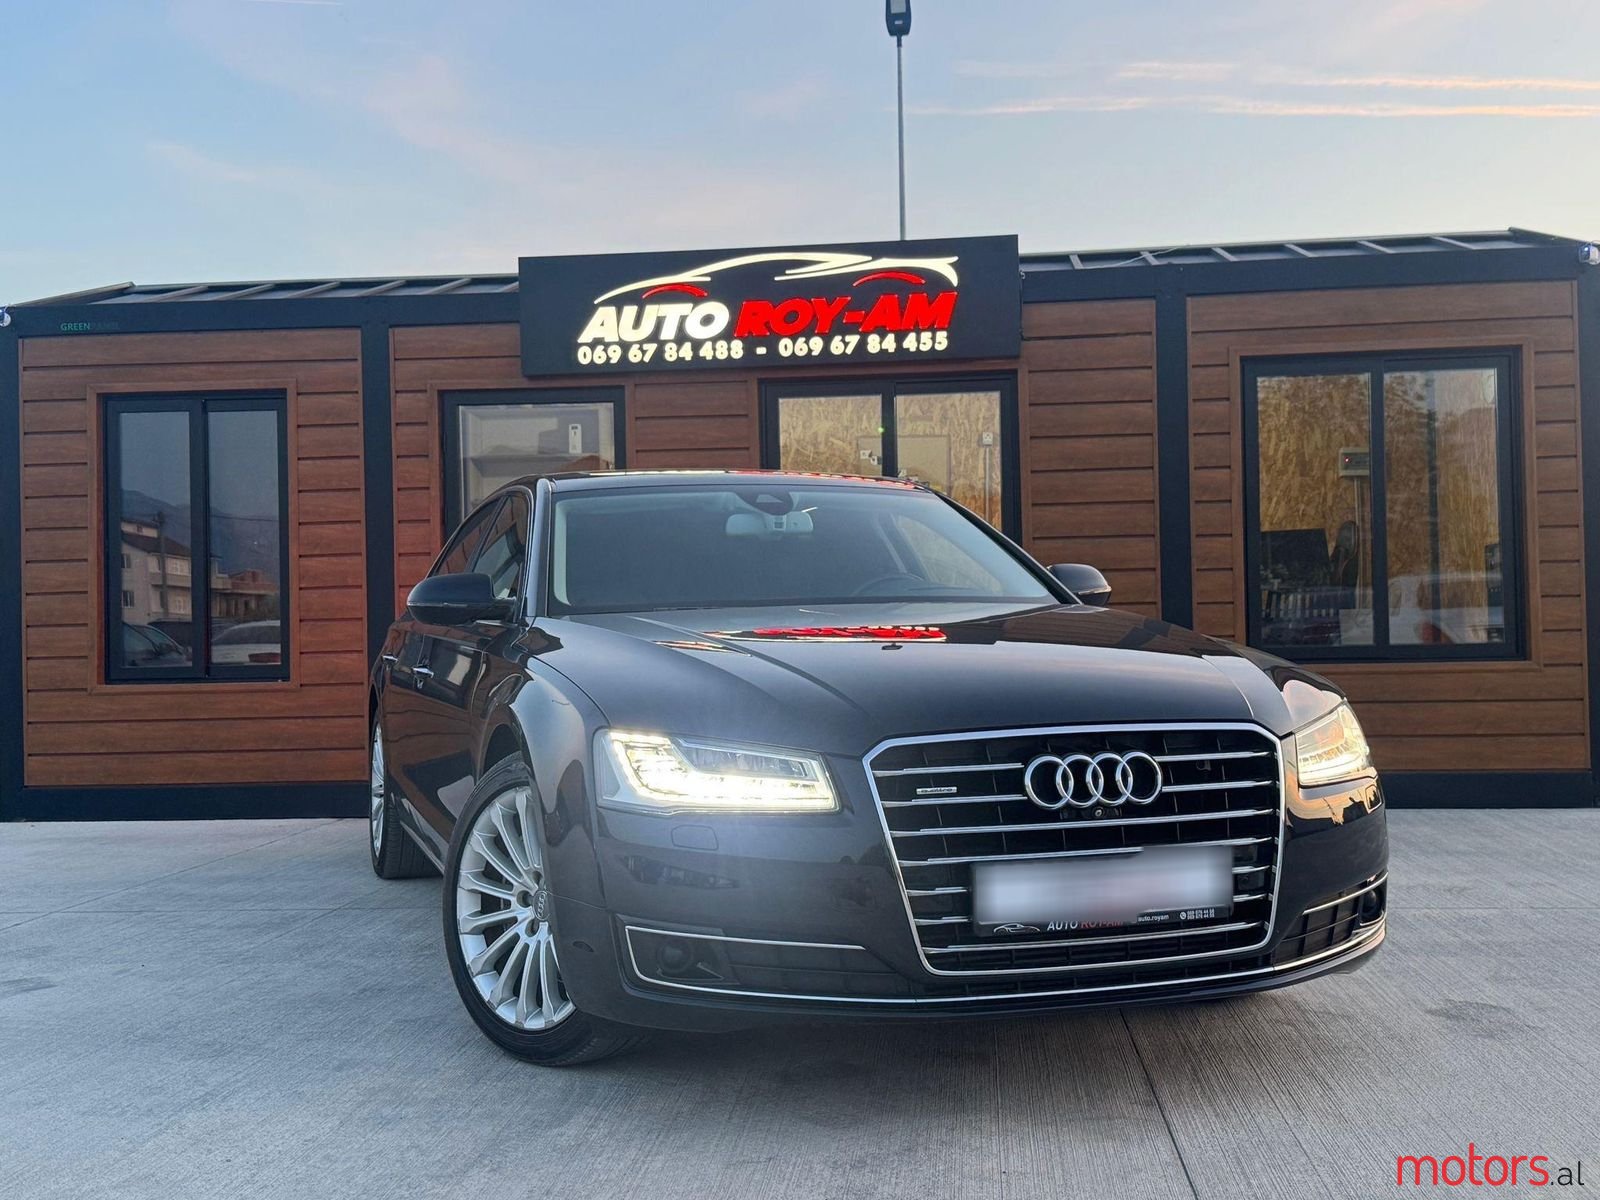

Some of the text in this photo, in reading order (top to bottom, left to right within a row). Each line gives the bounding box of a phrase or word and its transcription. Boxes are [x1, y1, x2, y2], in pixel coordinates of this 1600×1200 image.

[60, 322, 91, 331] GREEN
[577, 291, 959, 343] AUTO ROY-AM
[577, 345, 622, 365] 069
[628, 343, 657, 363] 67
[664, 342, 693, 362] 84
[699, 339, 744, 360] 488
[778, 337, 824, 357] 069
[830, 335, 860, 355] 67
[867, 333, 896, 354] 84
[902, 331, 948, 352] 455
[1047, 919, 1079, 931] AUTO
